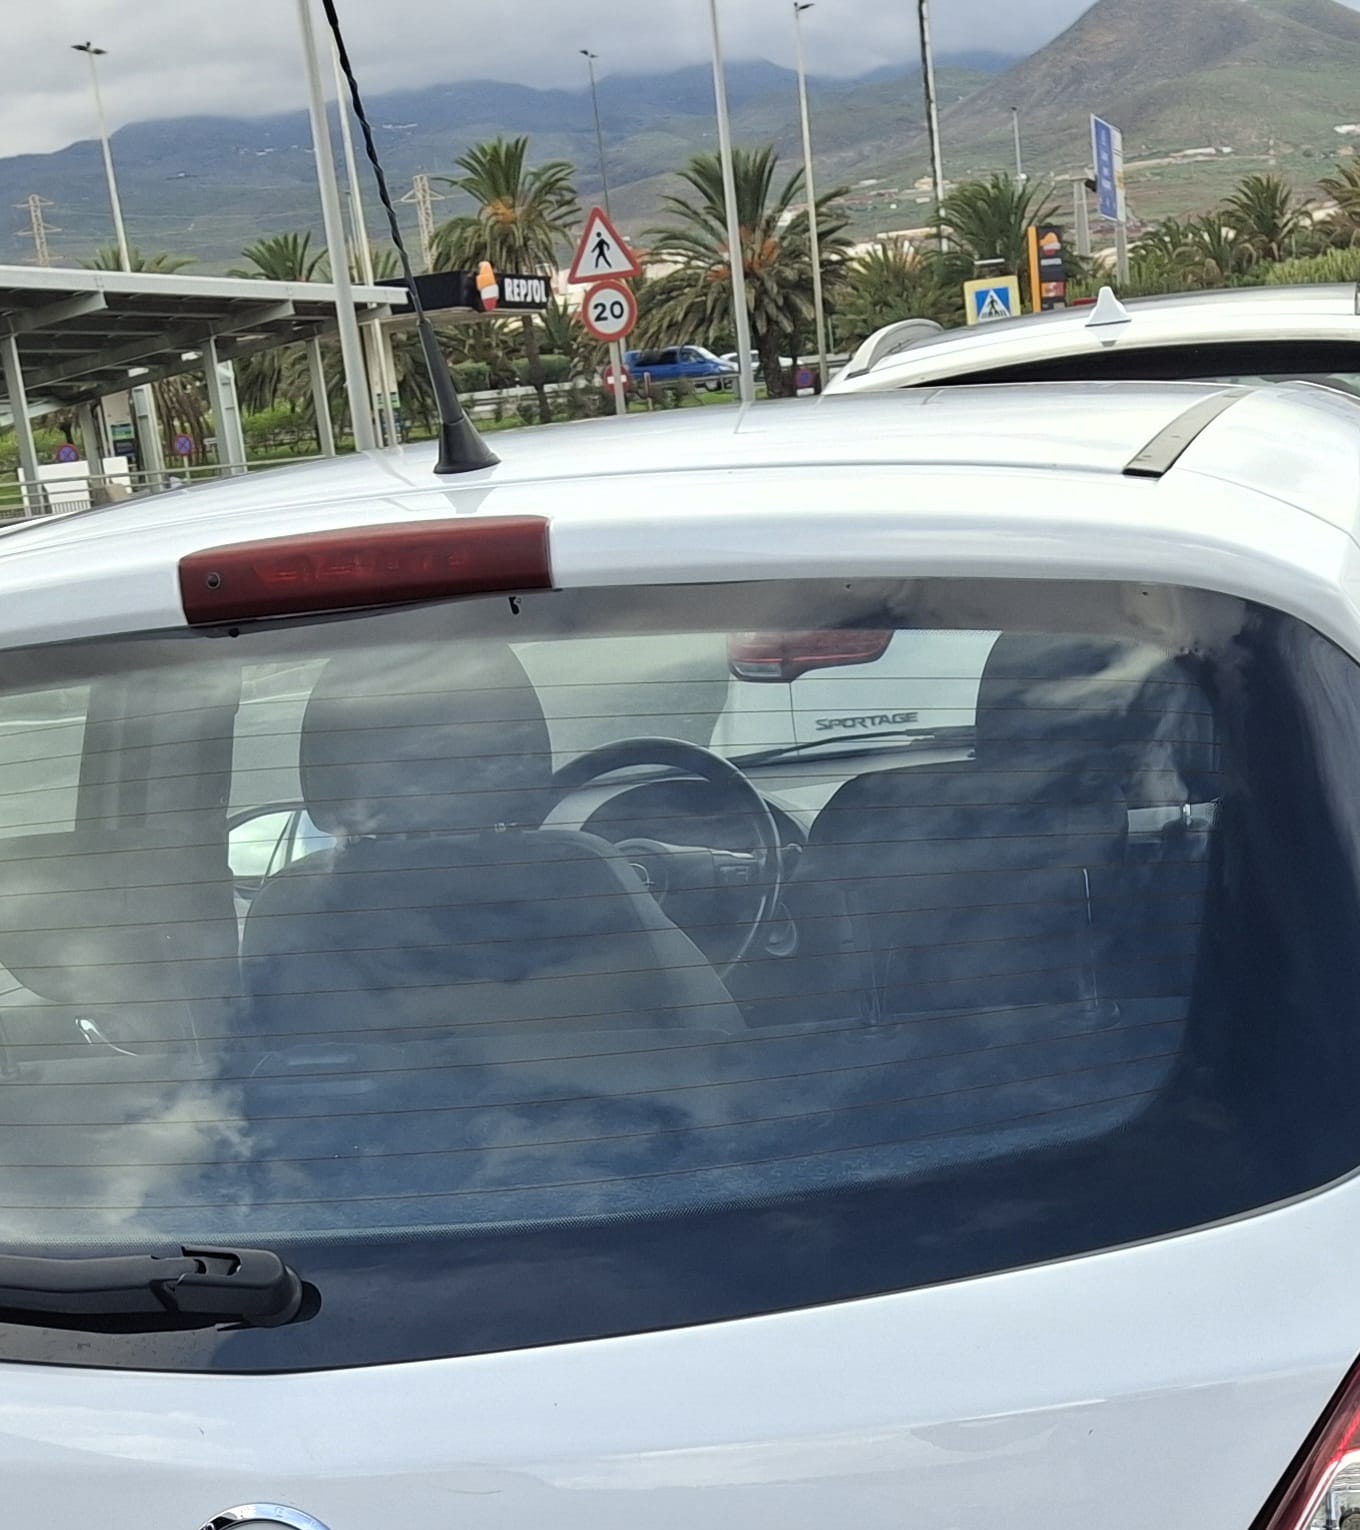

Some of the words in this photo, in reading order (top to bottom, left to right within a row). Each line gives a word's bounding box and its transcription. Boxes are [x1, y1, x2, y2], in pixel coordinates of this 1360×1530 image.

[504, 277, 547, 303] REPSOL
[593, 300, 624, 322] 20
[815, 711, 919, 731] SPORTAGE
